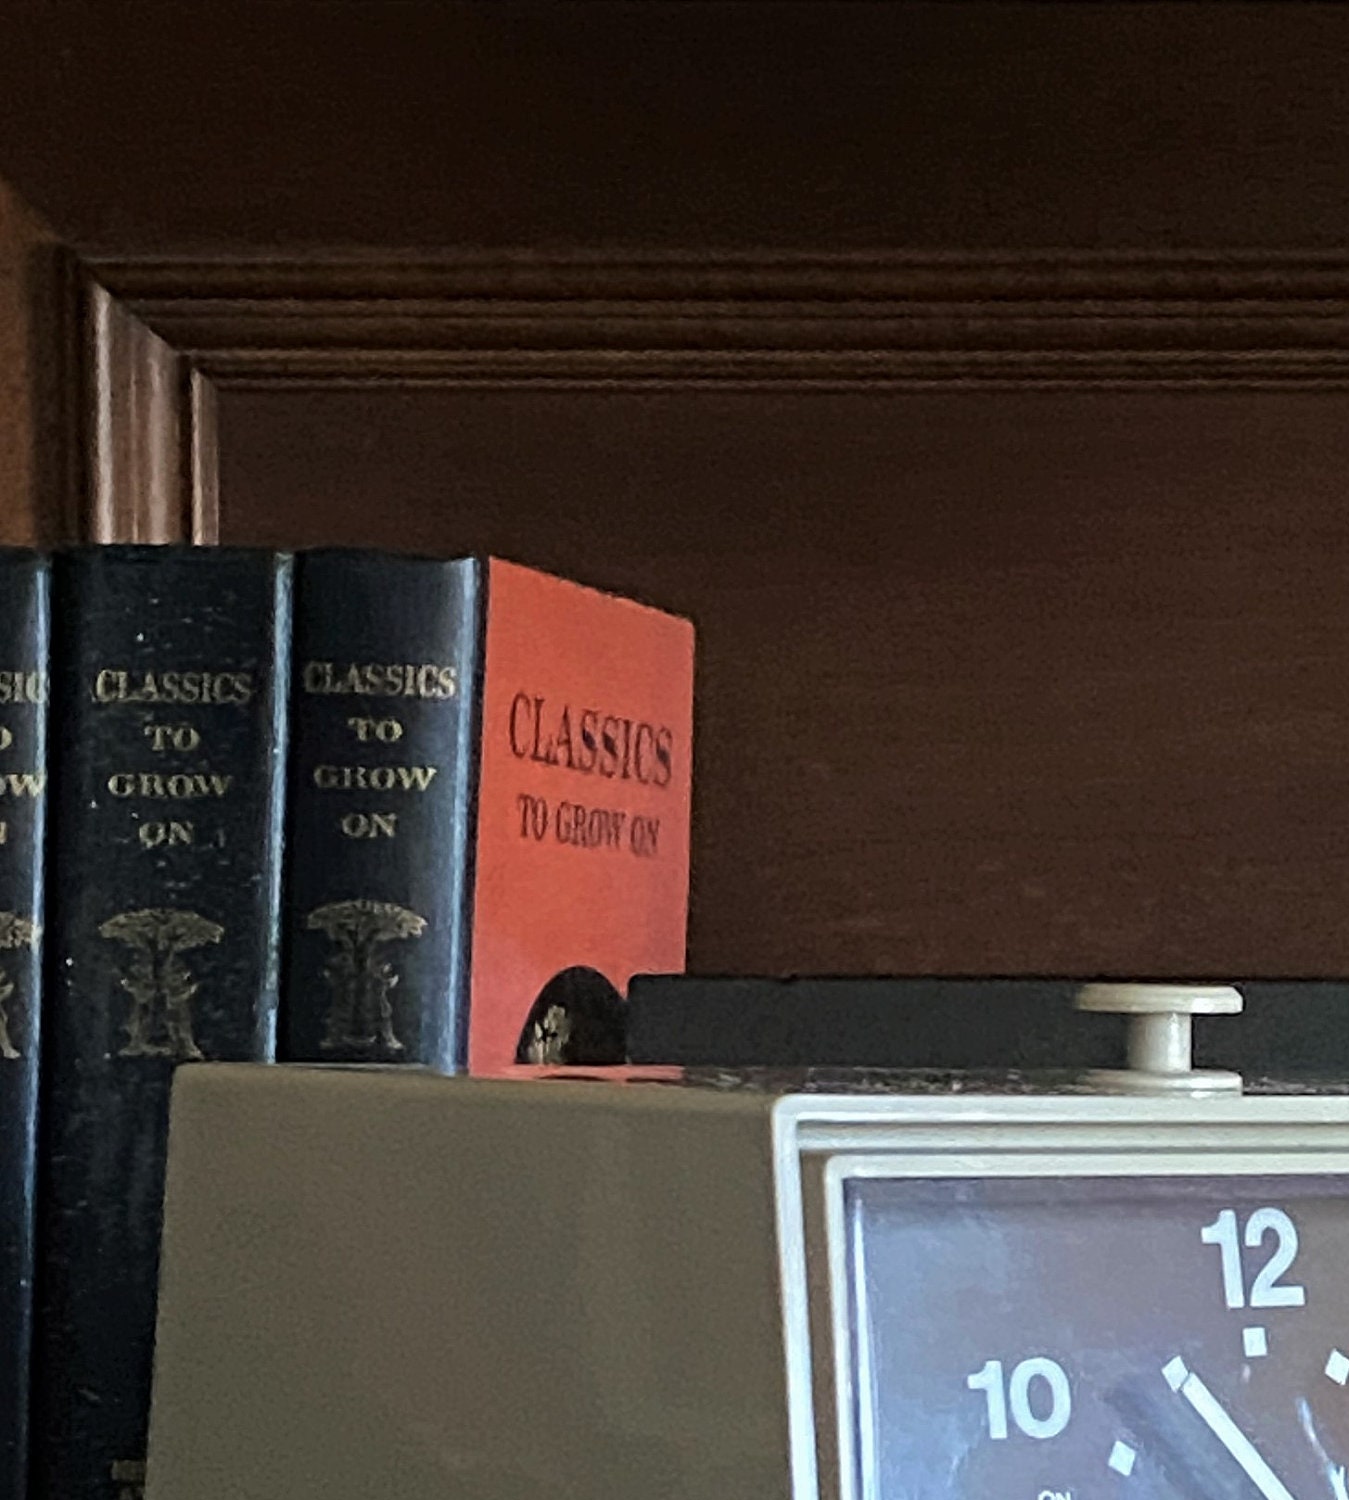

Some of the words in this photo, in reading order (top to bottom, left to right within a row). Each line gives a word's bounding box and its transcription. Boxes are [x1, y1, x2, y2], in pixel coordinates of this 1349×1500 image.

[95, 669, 252, 704] CLASSICS
[304, 661, 457, 699] CLASSICS
[144, 726, 200, 750] TO
[347, 717, 403, 742] TO
[508, 690, 674, 788] CLASSICS
[108, 773, 233, 797] GROW
[313, 765, 437, 792] GROW
[139, 821, 194, 847] ON
[341, 813, 397, 838] ON
[518, 793, 548, 842] TO
[555, 801, 626, 849] GROW
[630, 815, 661, 857] ON
[1201, 1207, 1305, 1308] 12
[967, 1356, 1072, 1439] 10
